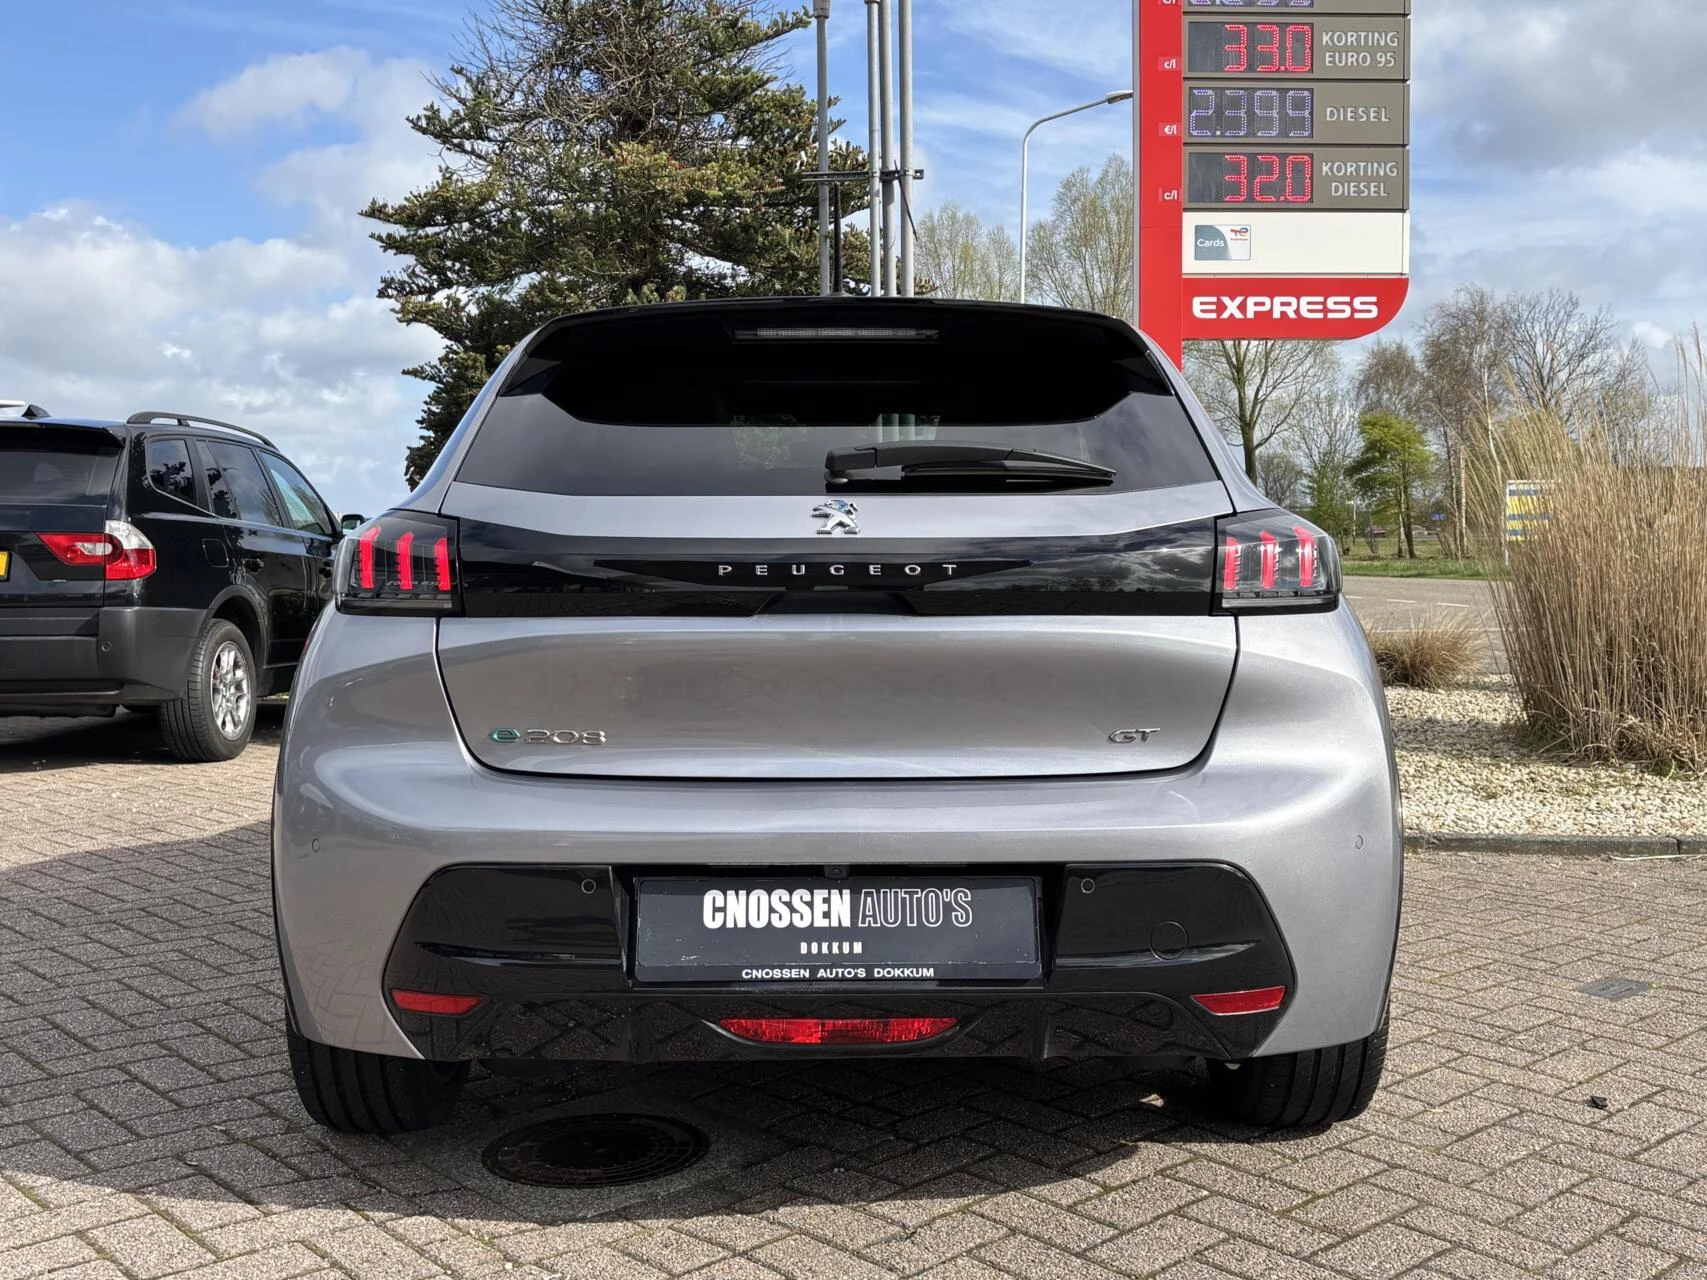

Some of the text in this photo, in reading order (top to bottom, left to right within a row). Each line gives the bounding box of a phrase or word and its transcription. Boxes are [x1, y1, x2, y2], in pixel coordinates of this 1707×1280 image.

[1322, 31, 1399, 46] KORTING
[1224, 24, 1312, 71] 33.0
[1325, 52, 1395, 66] EURO 95
[1189, 89, 1312, 136] 2.399
[1326, 107, 1390, 121] DIESEL
[1322, 161, 1398, 176] KORTING
[1224, 155, 1312, 201] 32.0
[1331, 182, 1388, 196] DIESEL
[1197, 238, 1225, 247] Cards
[1192, 296, 1379, 319] EXPRESS
[718, 564, 957, 576] PEUGEOT
[1108, 727, 1161, 744] GT
[702, 888, 973, 929] CNOSSEN AUTO'S
[800, 941, 863, 955] DOKKUM
[741, 967, 934, 979] CNOSSEN AUTO'S DOKKUM
